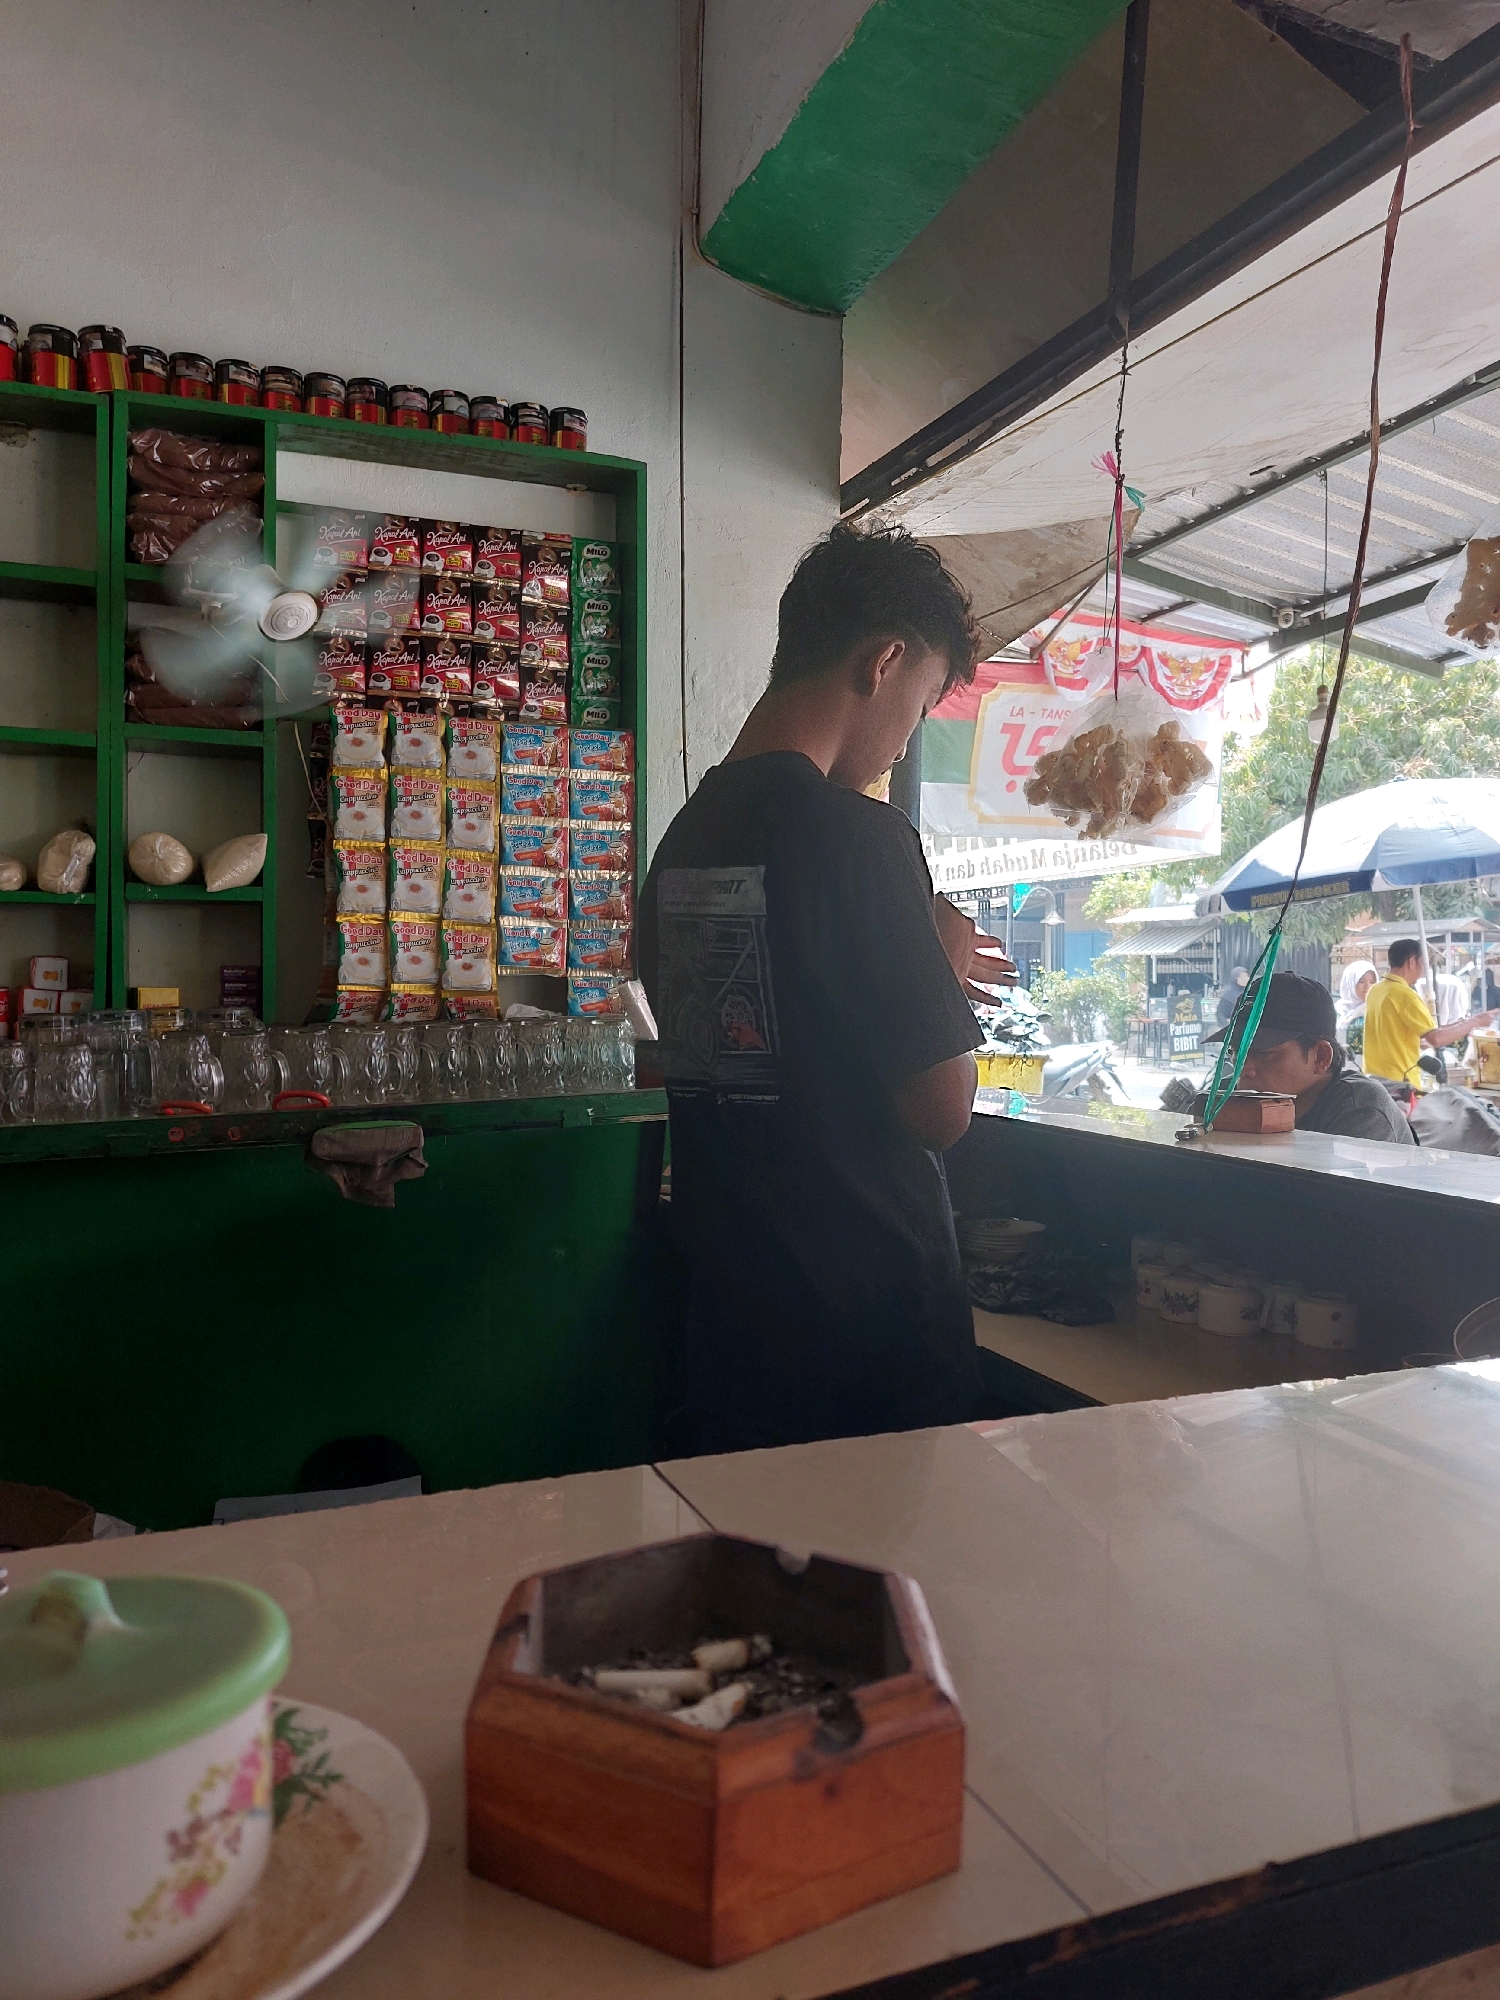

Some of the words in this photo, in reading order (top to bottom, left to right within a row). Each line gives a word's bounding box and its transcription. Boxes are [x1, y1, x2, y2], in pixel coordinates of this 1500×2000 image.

[345, 527, 361, 539] Api
[397, 529, 415, 539] Api
[451, 532, 466, 544] Api
[501, 541, 517, 552] Api
[586, 547, 608, 557] MILO
[551, 563, 567, 575] Api
[345, 590, 361, 602] Api
[397, 590, 415, 602] Api
[450, 594, 467, 606] Api
[501, 602, 517, 613] Api
[586, 602, 608, 611] MILO
[549, 622, 564, 634] Api
[343, 653, 361, 665] Api
[397, 652, 415, 664] Api
[450, 655, 466, 667] Api
[586, 656, 608, 665] MILO
[501, 661, 517, 673] Api
[548, 683, 563, 695] Api
[333, 708, 359, 718] Good
[361, 710, 381, 720] Day
[586, 710, 607, 719] MILO
[1010, 706, 1024, 718] LA
[338, 720, 376, 730] Cappuccino
[397, 721, 434, 730] Cappuccino
[449, 720, 474, 729] Good
[475, 721, 494, 733] Day
[453, 733, 489, 743] Cappuccino
[335, 779, 362, 789] Good
[363, 780, 382, 792] Day
[393, 779, 419, 788] Good
[421, 781, 439, 792] Day
[340, 792, 378, 804] Cappuccino
[398, 792, 435, 804] Cappuccino
[449, 791, 474, 801] Good
[475, 793, 493, 805] Day
[452, 804, 488, 815] Cappuccino
[337, 852, 363, 863] Good
[364, 854, 383, 866] Day
[393, 851, 419, 862] Good
[420, 853, 439, 865] Day
[343, 866, 379, 876] Cappuccino
[397, 865, 433, 876] Cappuccino
[447, 861, 471, 872] Good
[473, 863, 491, 876] Day
[341, 925, 364, 936] Good
[366, 927, 385, 938] Day
[392, 924, 416, 935] Good
[418, 926, 436, 938] Day
[345, 938, 381, 949] Cappuccino
[397, 938, 431, 949] Cappuccino
[444, 933, 469, 943] Good
[470, 934, 489, 946] Day
[448, 946, 484, 956] Cappuccino
[392, 996, 417, 1004] Good
[418, 997, 436, 1006] Day
[445, 999, 471, 1008] Good
[472, 1000, 492, 1008] Day
[1174, 1035, 1200, 1052] BIBIT
